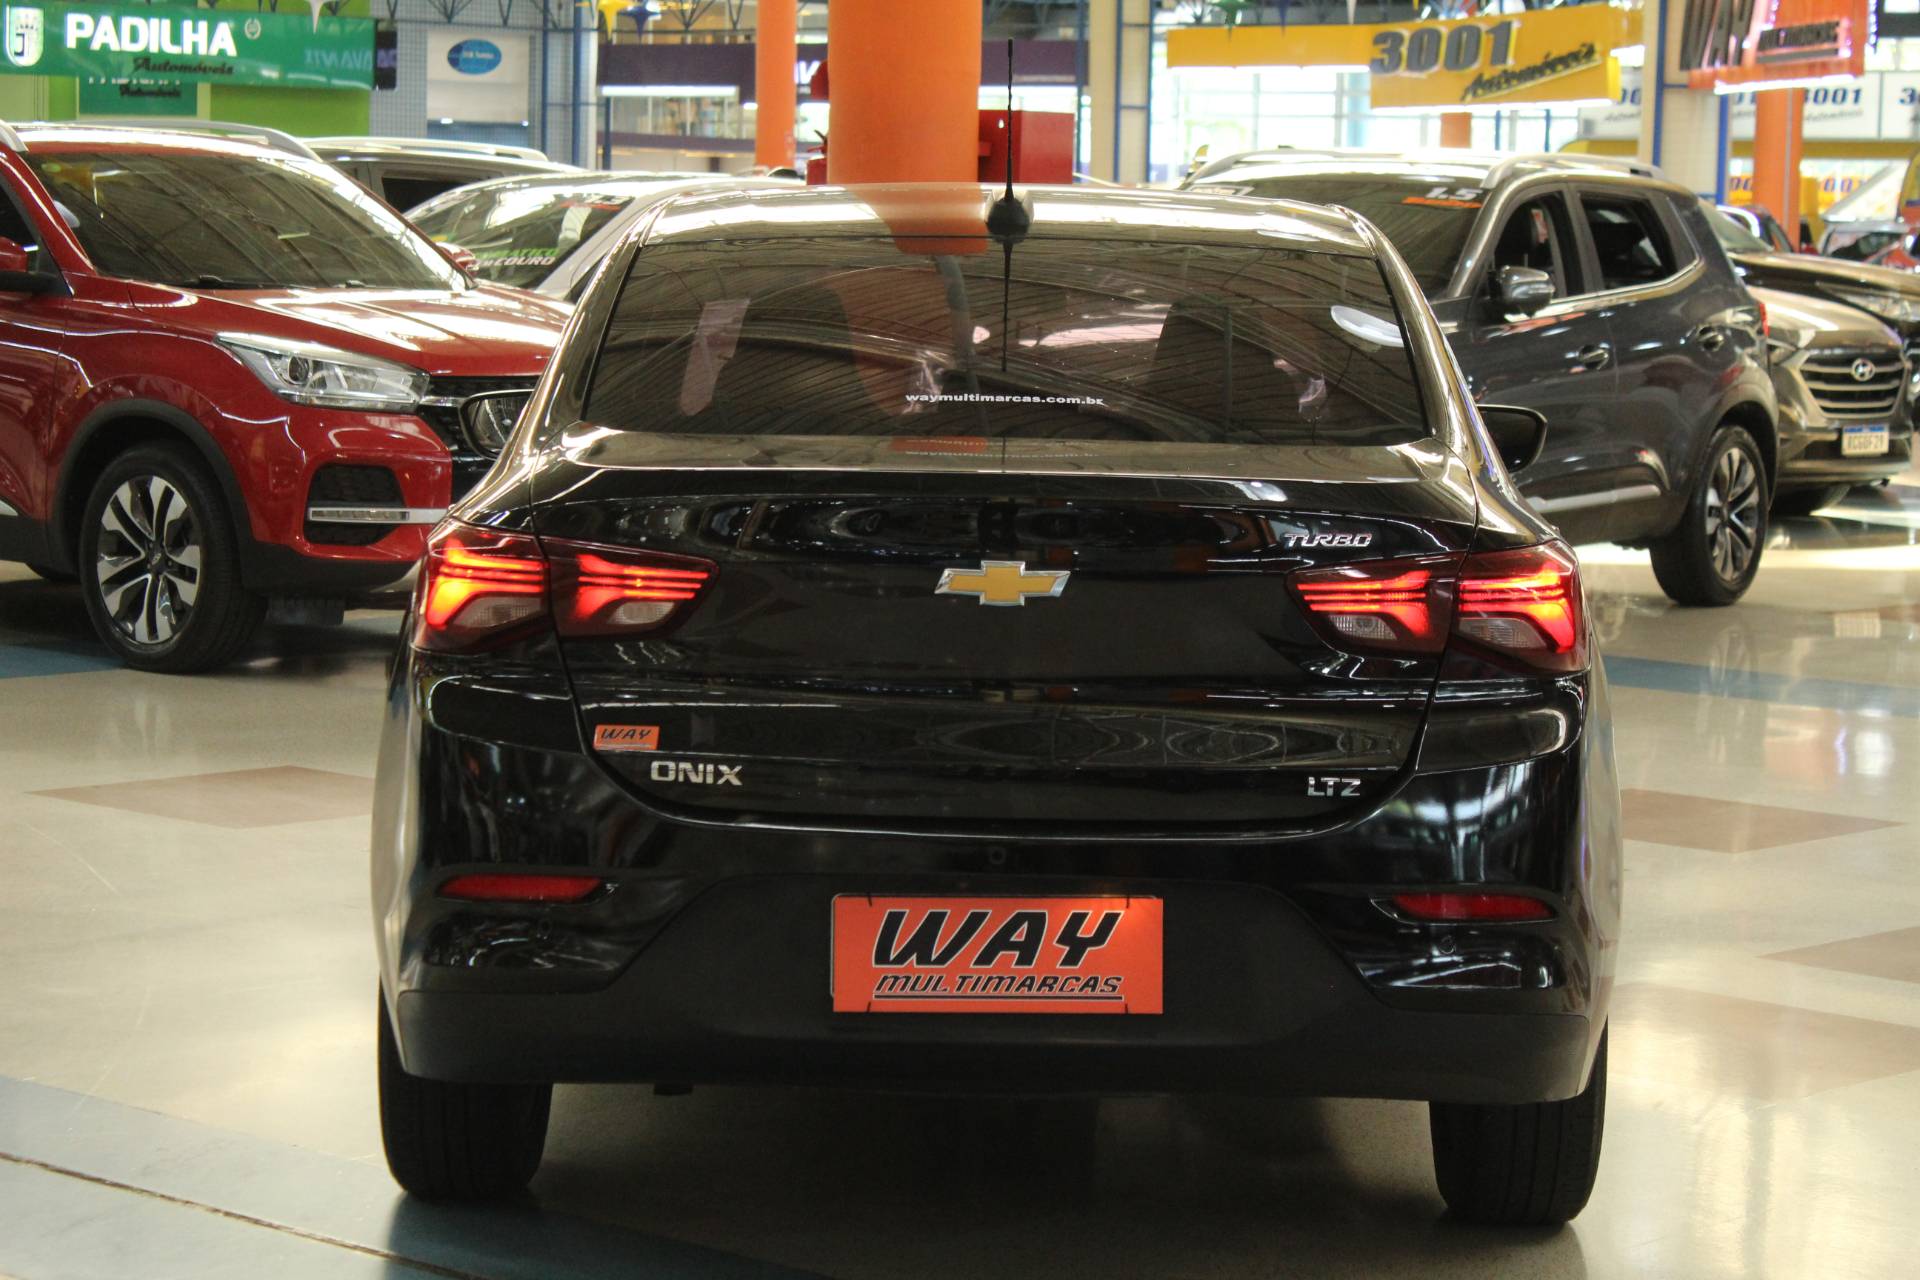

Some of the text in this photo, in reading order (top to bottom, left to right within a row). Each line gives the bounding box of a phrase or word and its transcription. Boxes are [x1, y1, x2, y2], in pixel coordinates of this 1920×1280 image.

[66, 13, 238, 57] PADILHA
[1370, 20, 1518, 75] 3001
[905, 393, 1105, 405] waymultimarcas.com.br
[1284, 533, 1373, 548] TURBO
[601, 728, 651, 740] WAY
[651, 760, 743, 786] ONIX
[1307, 776, 1361, 797] LTZ
[873, 909, 1124, 968] WAY
[873, 973, 1124, 994] MULTIMARCAS
